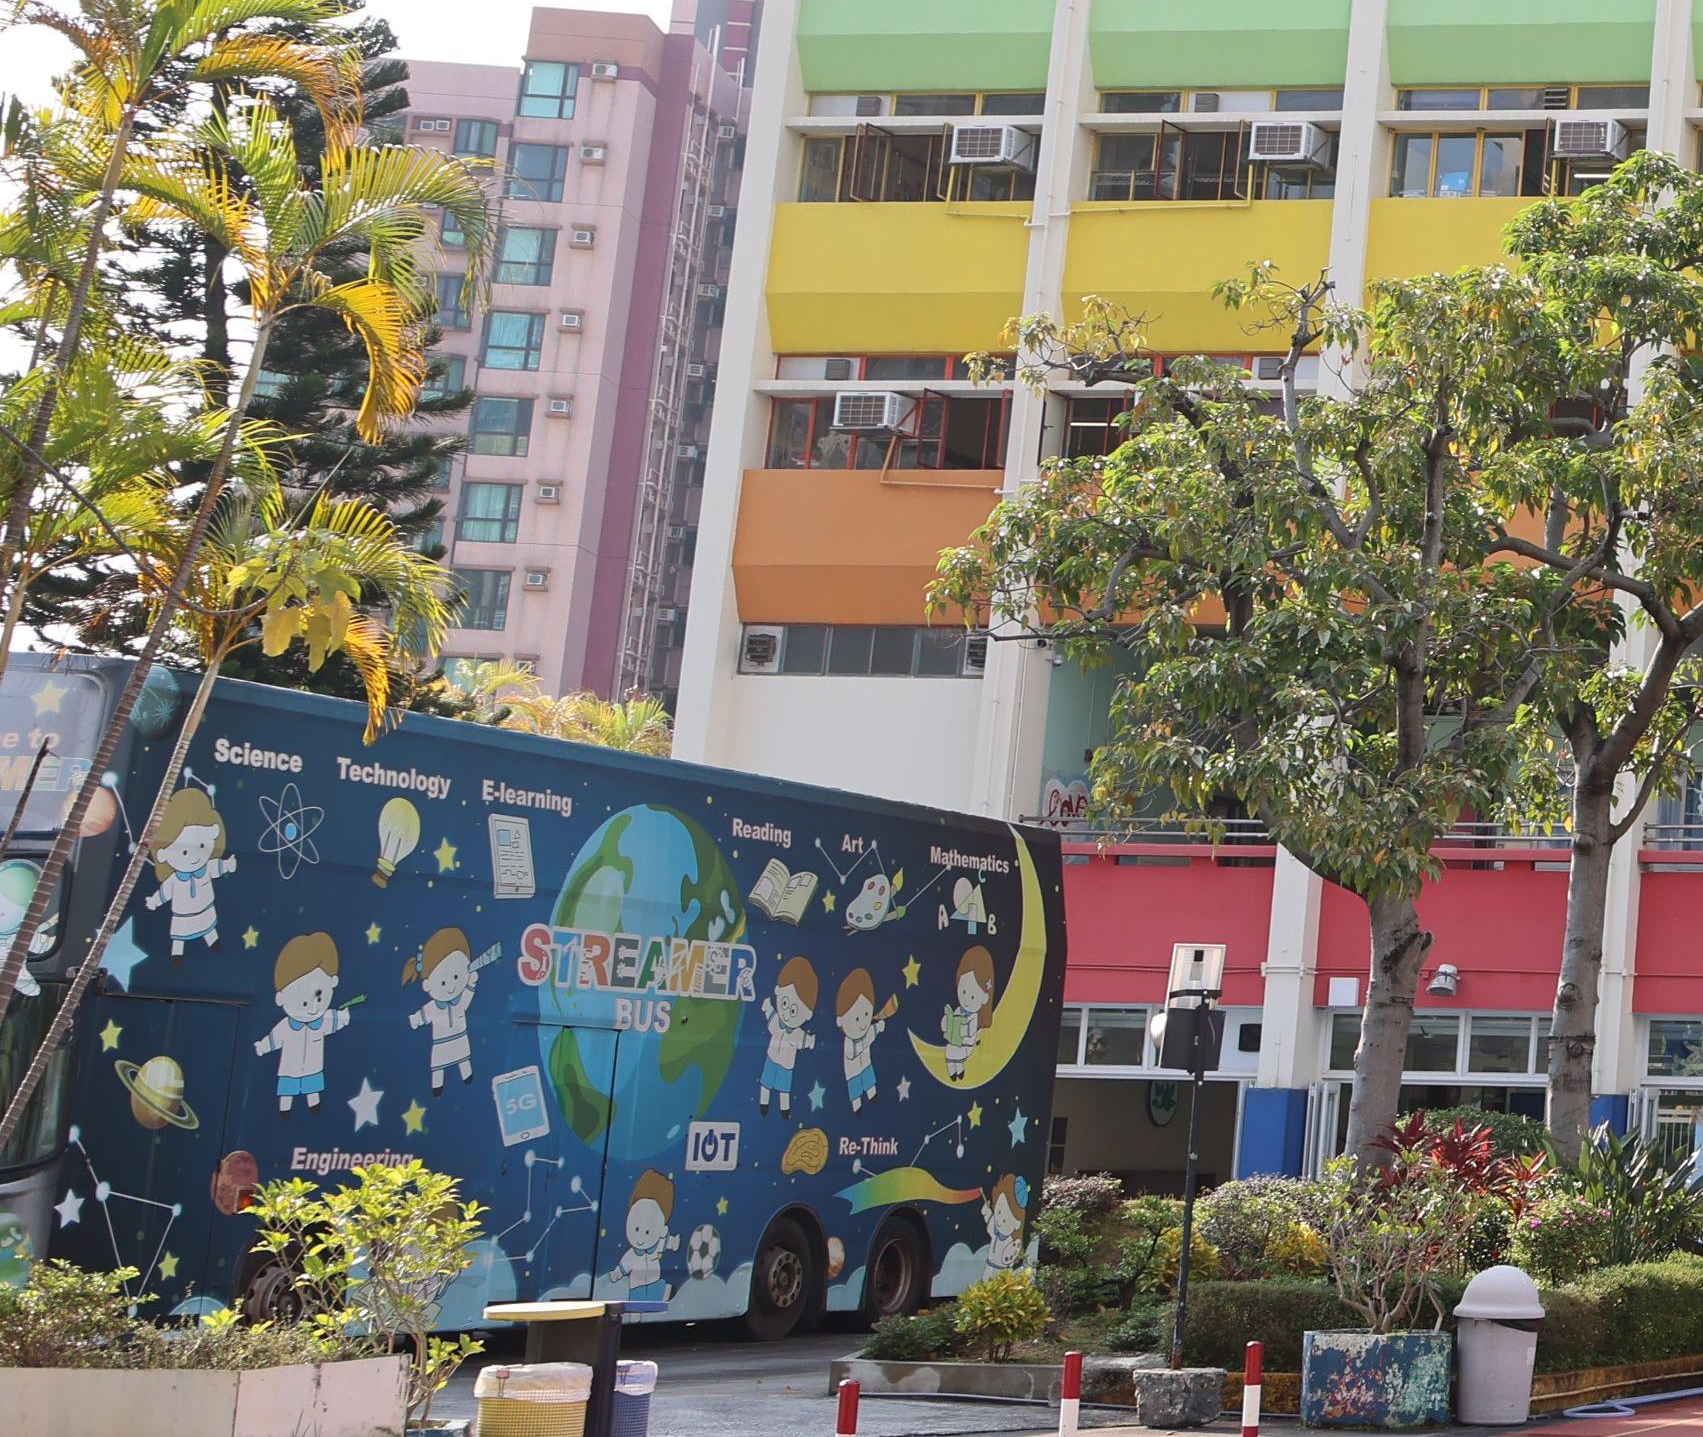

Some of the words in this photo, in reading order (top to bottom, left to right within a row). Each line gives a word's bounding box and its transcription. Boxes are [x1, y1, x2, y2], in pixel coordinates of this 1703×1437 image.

[214, 738, 304, 774] Science
[336, 756, 452, 800] Technology
[482, 779, 573, 818] E-learning
[732, 817, 792, 849] Reading
[841, 833, 864, 854] Art
[930, 846, 1010, 874] Mathematics
[938, 903, 949, 930] A
[987, 913, 997, 935] B
[517, 922, 757, 1002] STREAMER
[615, 998, 671, 1033] BUS
[505, 1093, 538, 1115] 5G
[839, 1137, 899, 1155] Re-Think
